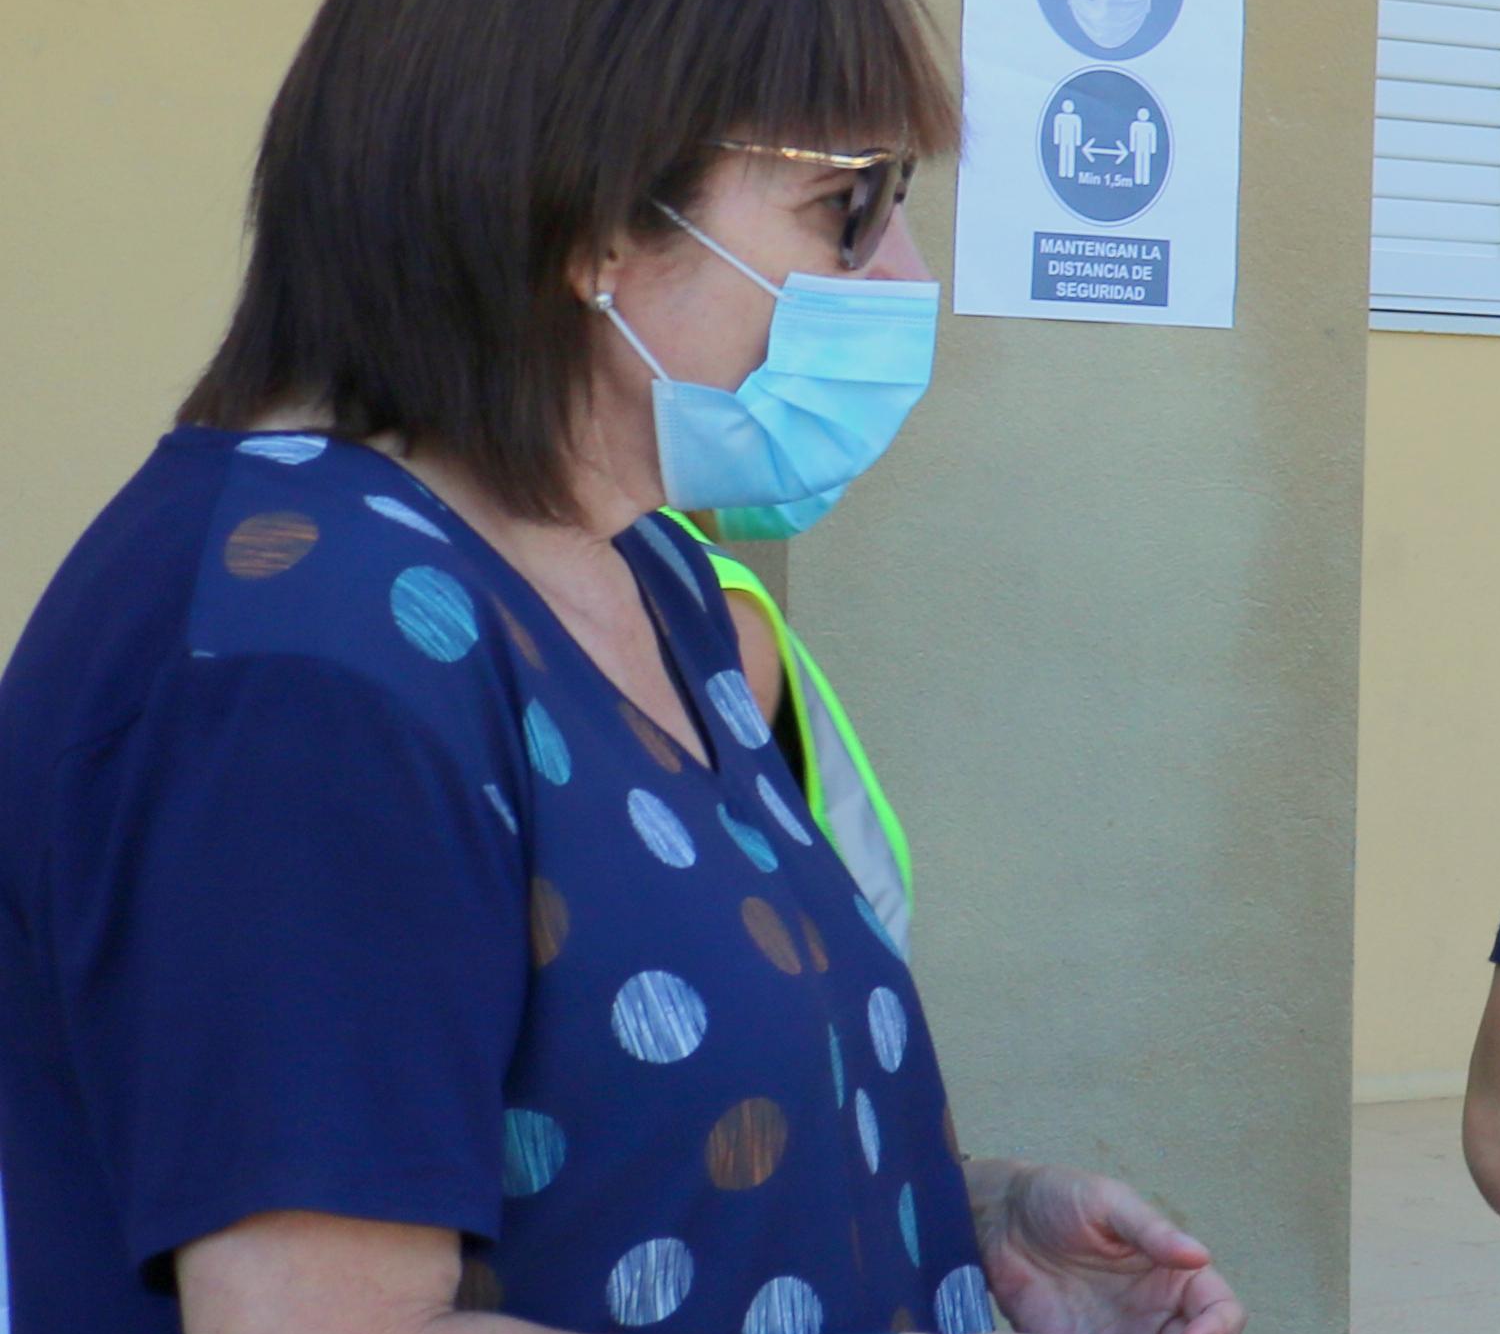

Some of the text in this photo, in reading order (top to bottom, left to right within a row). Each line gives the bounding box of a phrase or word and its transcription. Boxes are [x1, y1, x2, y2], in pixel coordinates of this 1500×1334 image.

[1078, 171, 1134, 188] Min 1,5m
[1040, 238, 1162, 260] MANTENGAN LA
[1048, 260, 1153, 281] DISTANCIA DE
[1056, 281, 1145, 301] SEGURIDAD
